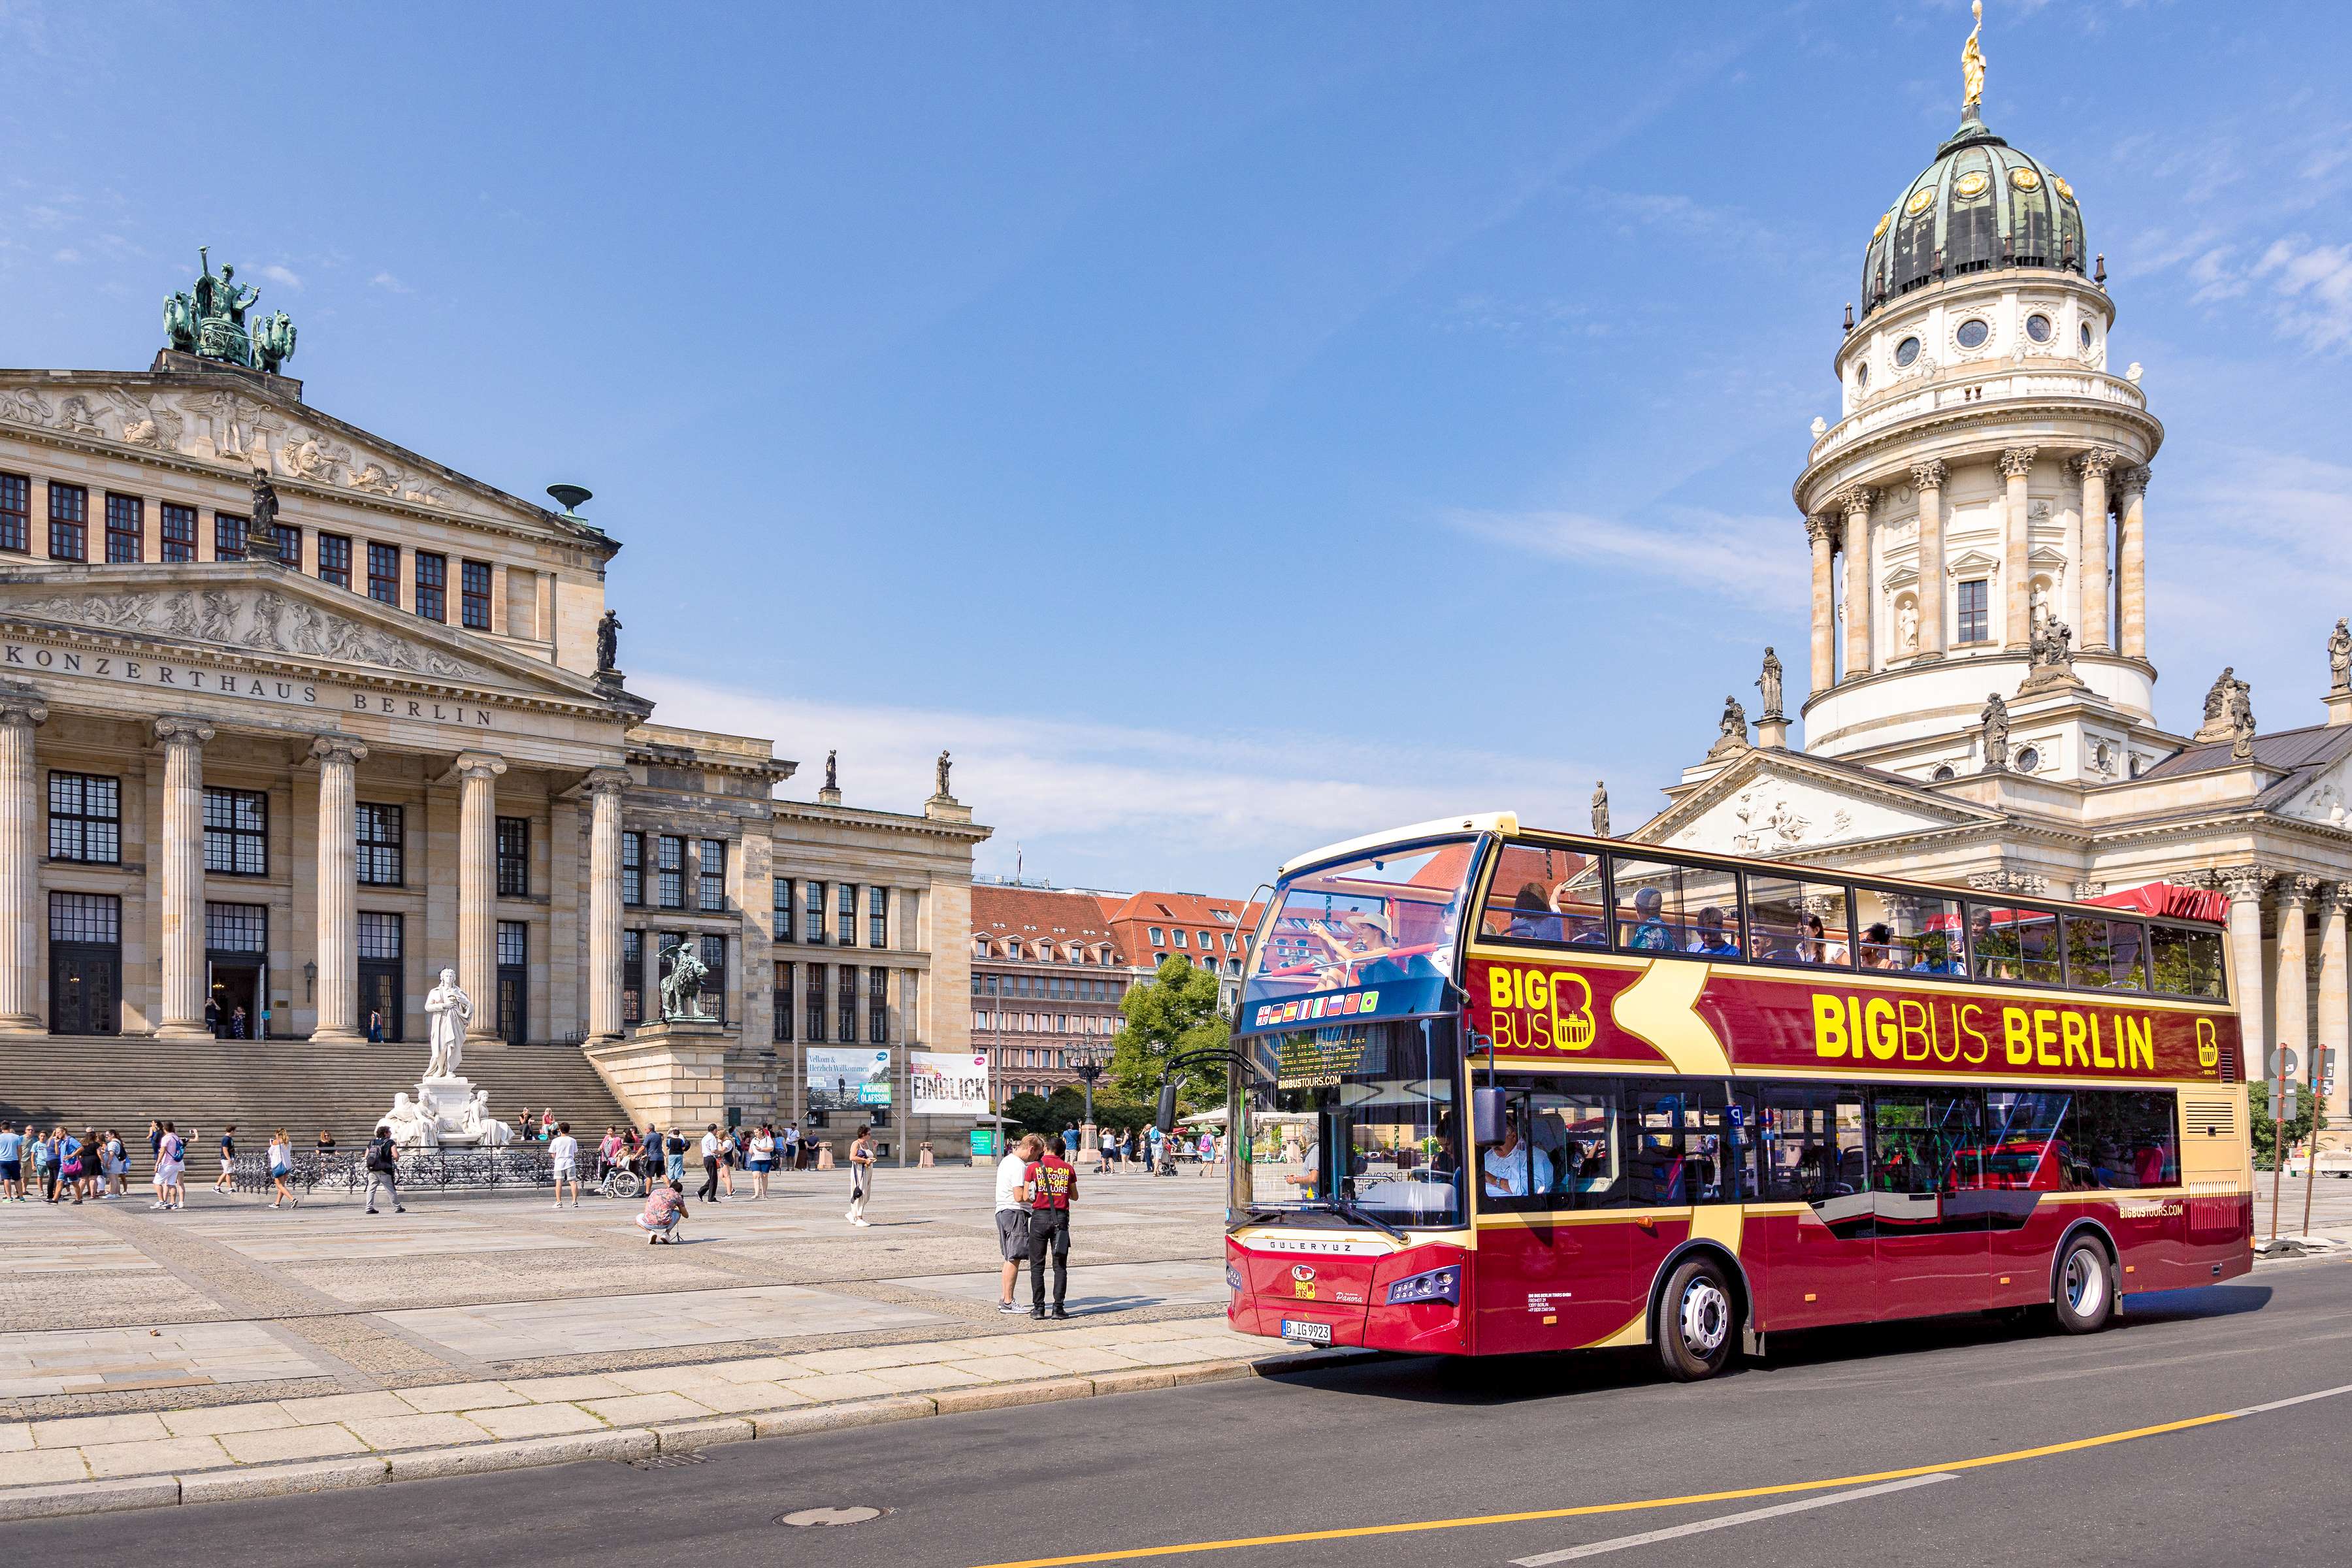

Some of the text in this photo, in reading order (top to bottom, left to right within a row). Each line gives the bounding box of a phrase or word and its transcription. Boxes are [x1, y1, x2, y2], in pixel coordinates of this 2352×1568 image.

[5, 645, 491, 725] KONZERTHAUS BERLIN
[1488, 967, 1548, 1010] BIG
[1492, 1011, 1551, 1049] BUS
[1812, 993, 2155, 1070] BIGBUS BERLIN
[913, 1077, 987, 1100] EINBLICK
[1278, 1075, 1341, 1090] BIGBUSTOURS.COM
[2119, 1204, 2183, 1218] BIGBUSTOURS.COM
[1295, 1281, 1307, 1290] BIG
[1296, 1290, 1307, 1299] BUS
[1335, 1292, 1364, 1303] Panora
[1286, 1322, 1328, 1338] B IG 9923
